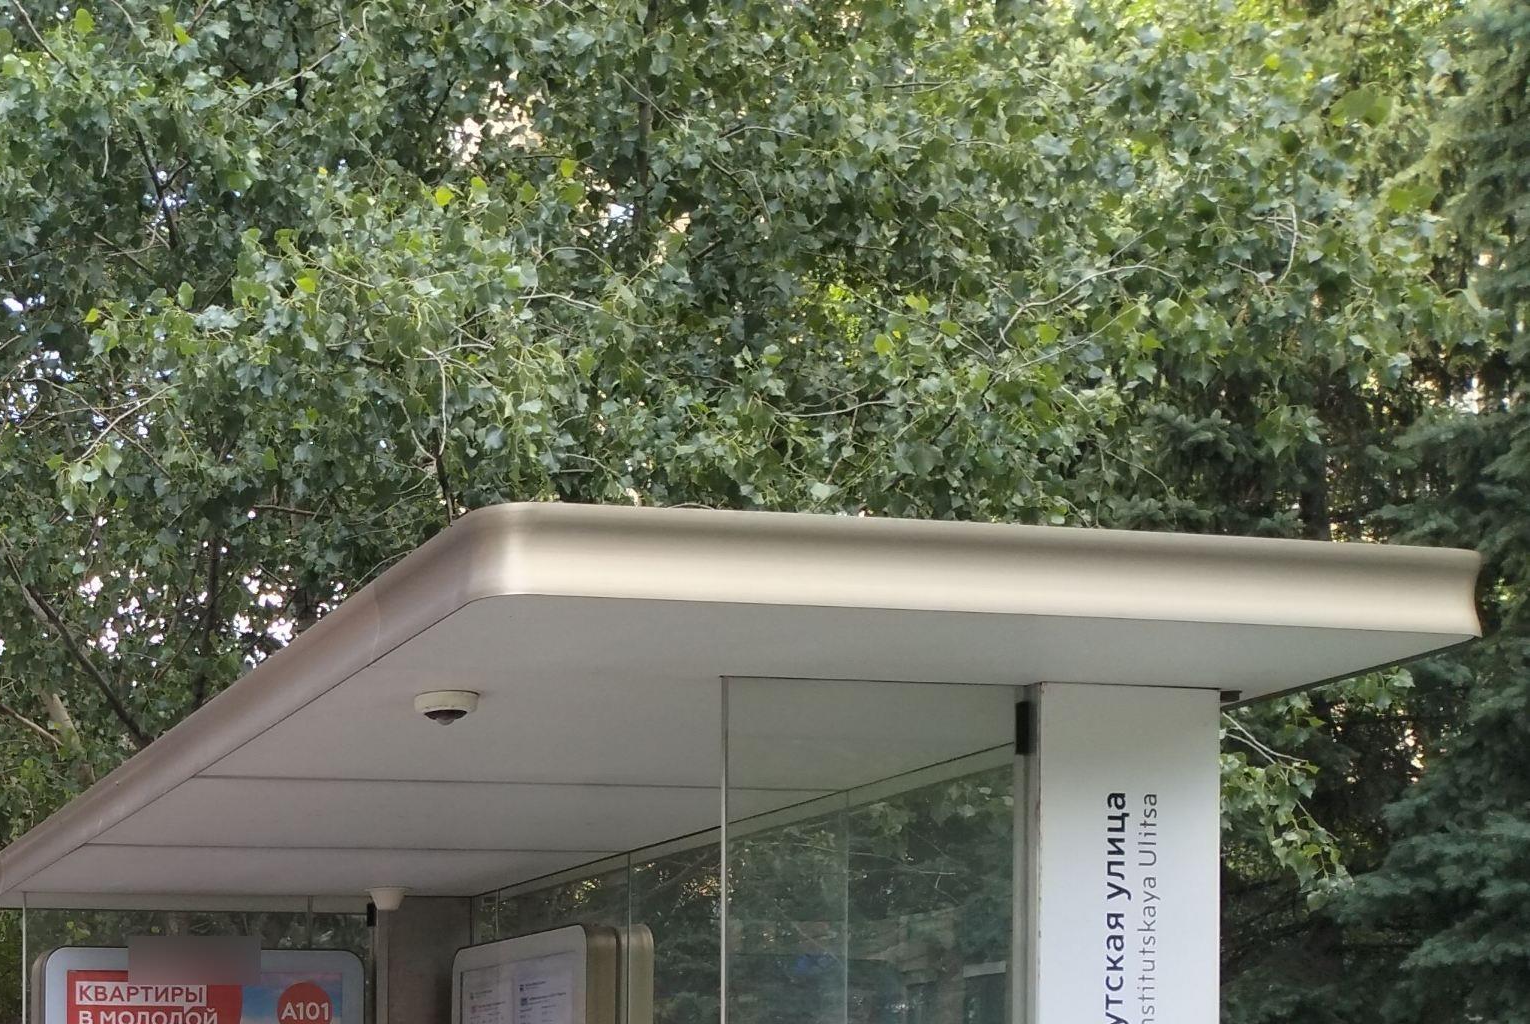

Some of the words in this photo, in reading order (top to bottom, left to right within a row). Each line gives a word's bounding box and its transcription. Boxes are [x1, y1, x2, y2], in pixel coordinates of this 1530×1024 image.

[1106, 791, 1132, 901] улица
[1138, 793, 1158, 867] Ulitsa
[79, 985, 204, 1003] КВАРТИРЫ
